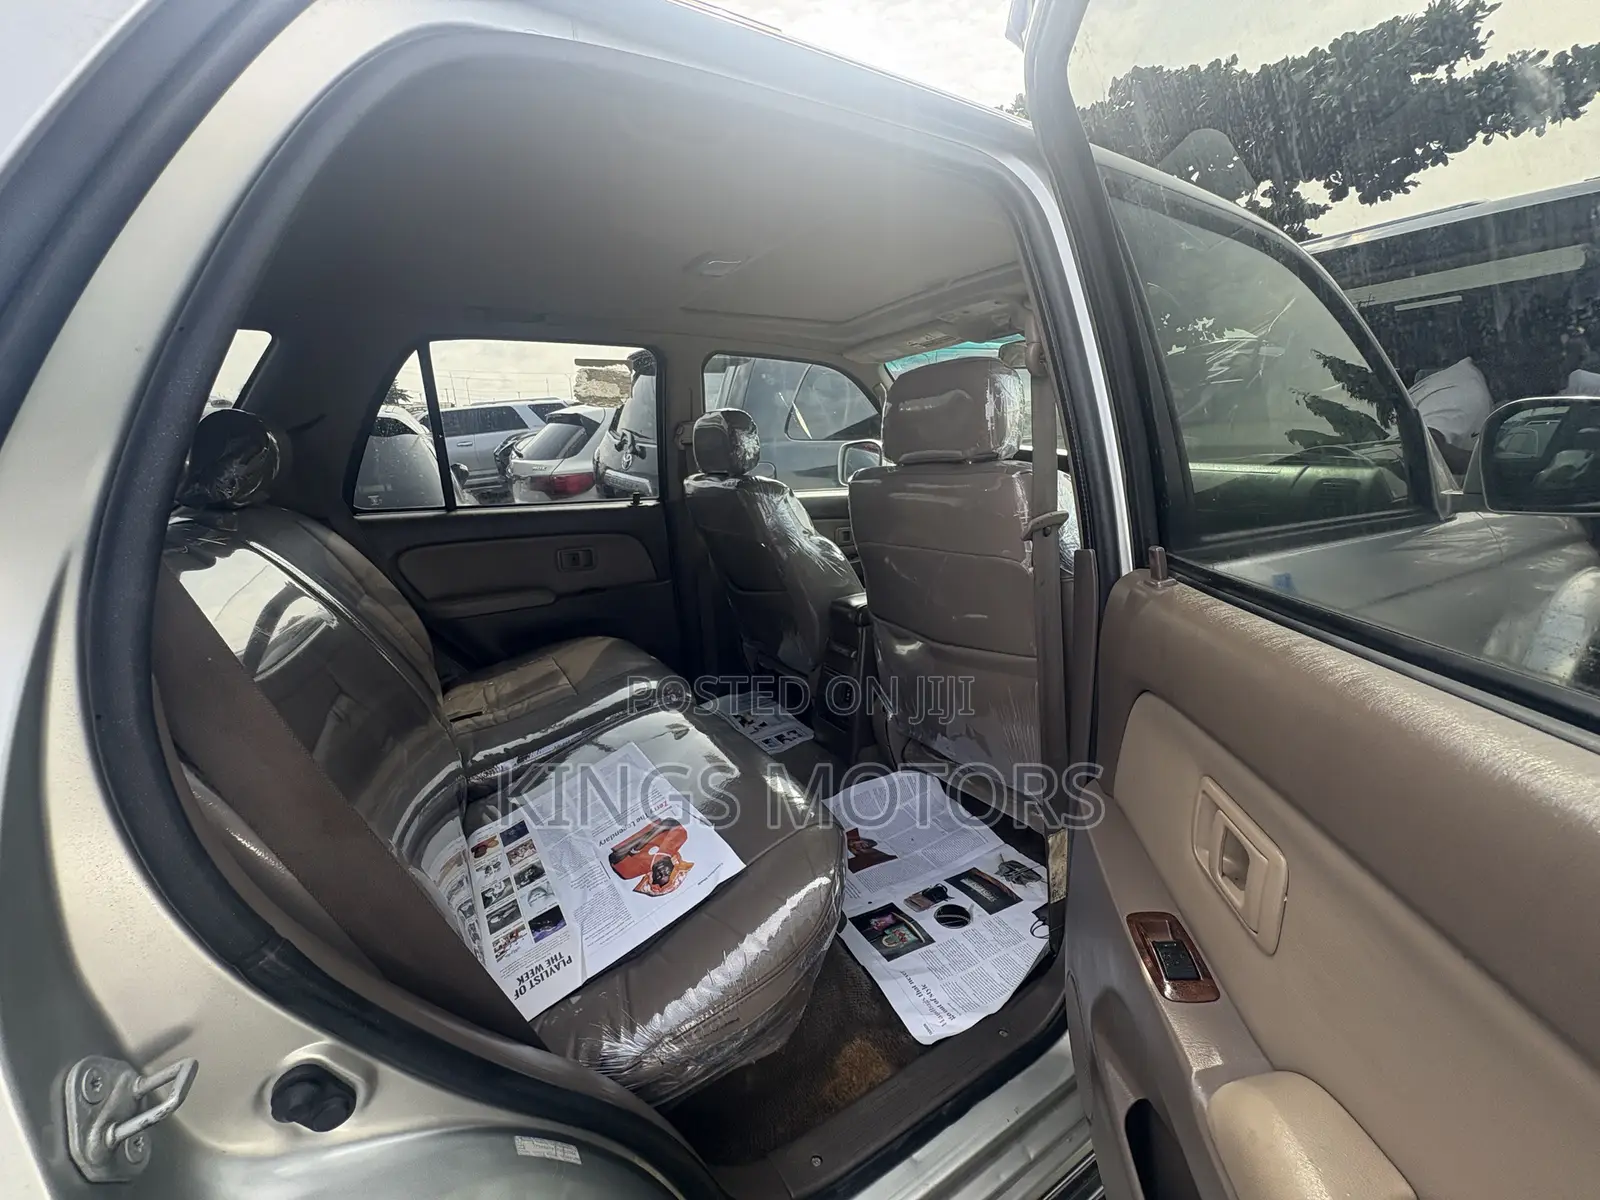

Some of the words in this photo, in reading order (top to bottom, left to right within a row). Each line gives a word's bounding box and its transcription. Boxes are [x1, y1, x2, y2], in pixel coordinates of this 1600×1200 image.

[636, 812, 648, 822] The
[599, 821, 636, 847] Legendary
[544, 952, 563, 967] THE
[516, 964, 544, 985] WEEK
[528, 955, 572, 990] PLAYLIST
[900, 970, 914, 985] never
[513, 984, 526, 1000] OF
[912, 984, 923, 998] that
[921, 983, 934, 998] style
[936, 1003, 947, 1013] out
[946, 1012, 956, 1021] go
